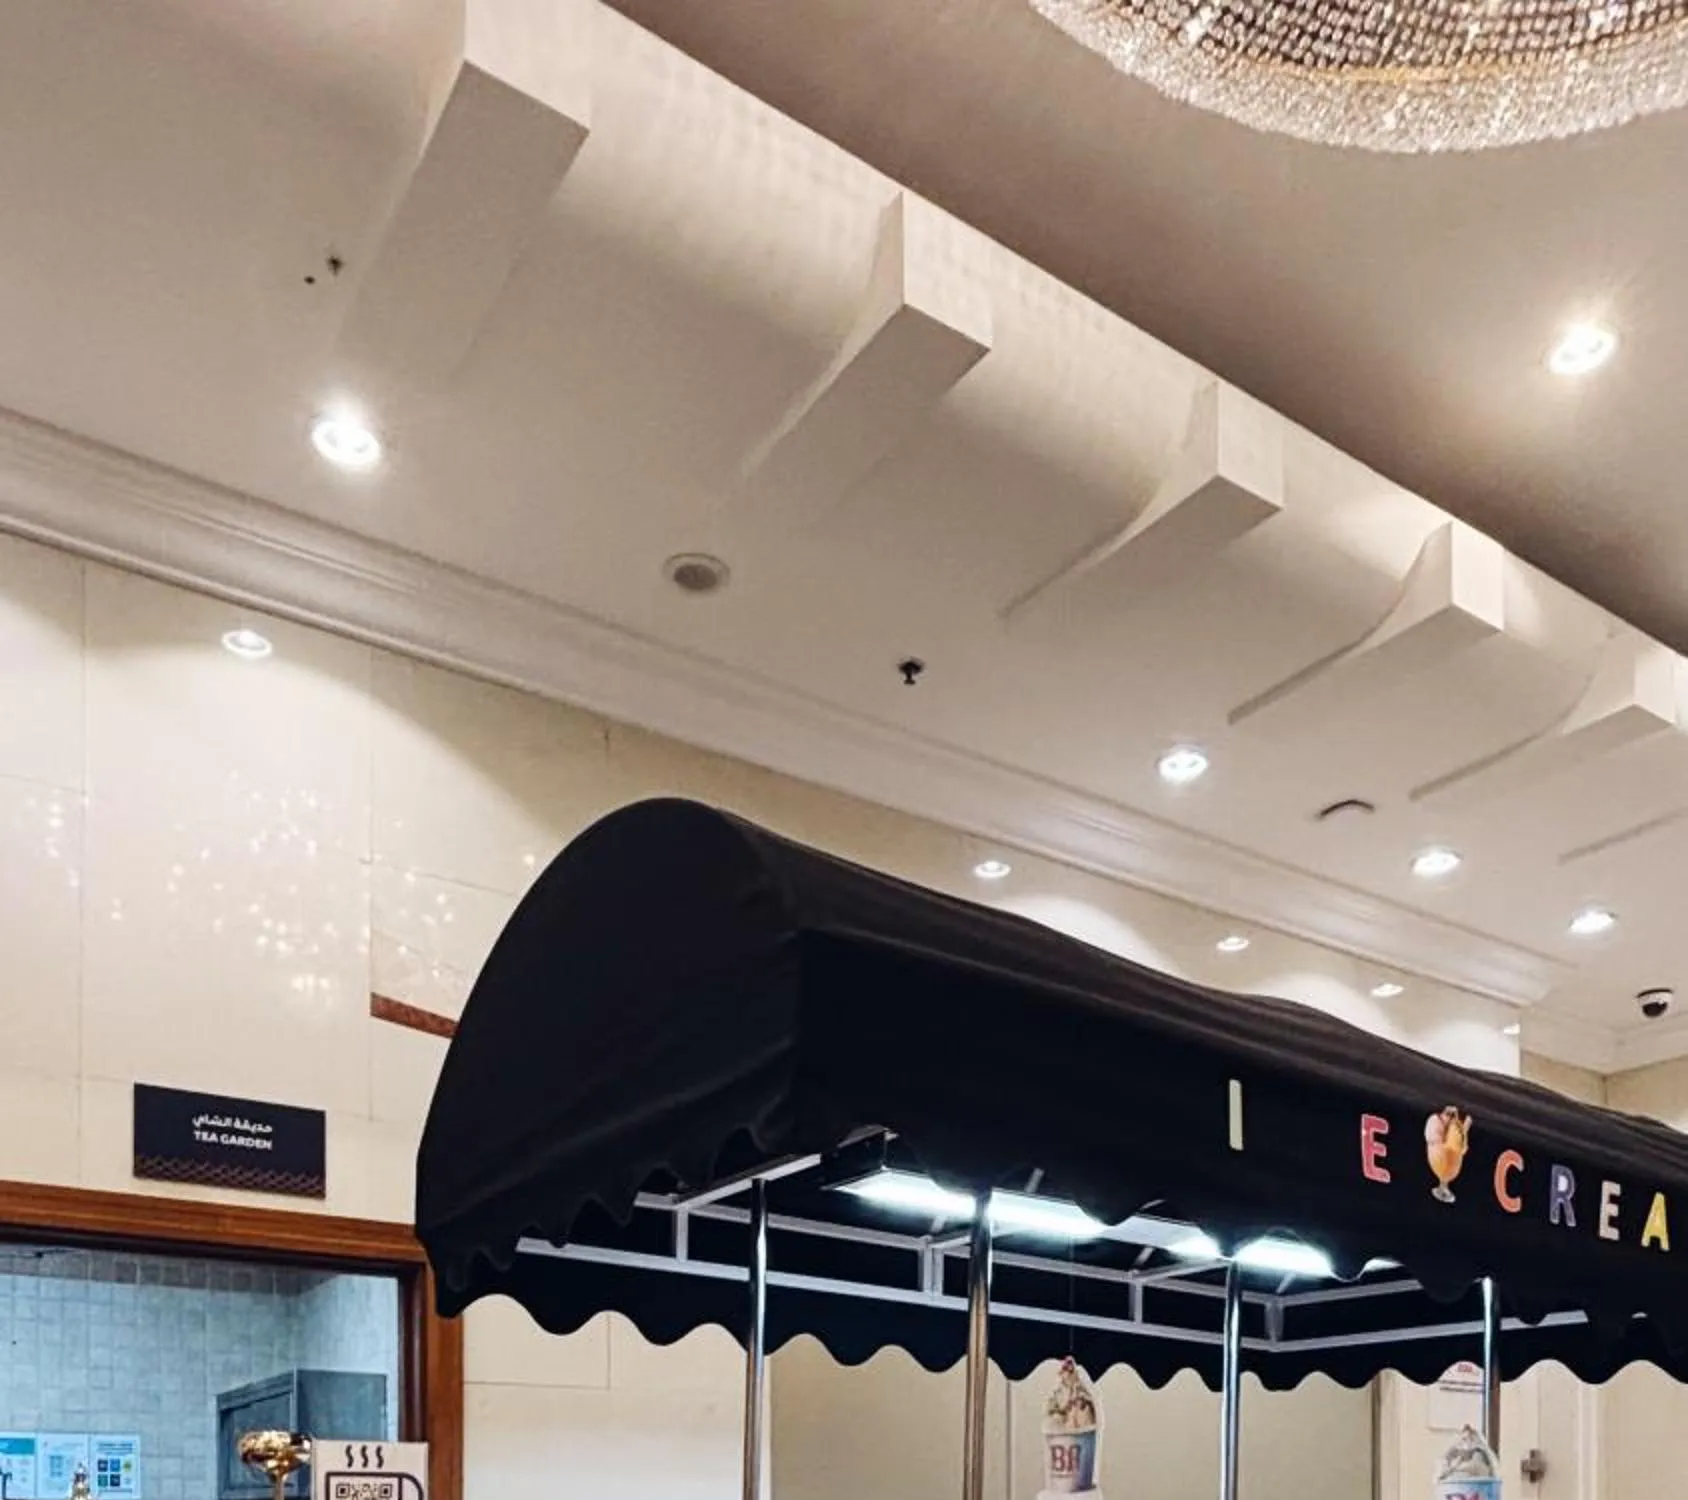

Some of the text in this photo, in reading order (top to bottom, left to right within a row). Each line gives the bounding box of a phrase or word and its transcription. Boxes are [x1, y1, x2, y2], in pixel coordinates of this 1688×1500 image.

[191, 1113, 273, 1134] حديقة الشاي
[193, 1130, 273, 1151] TEA GARDEN
